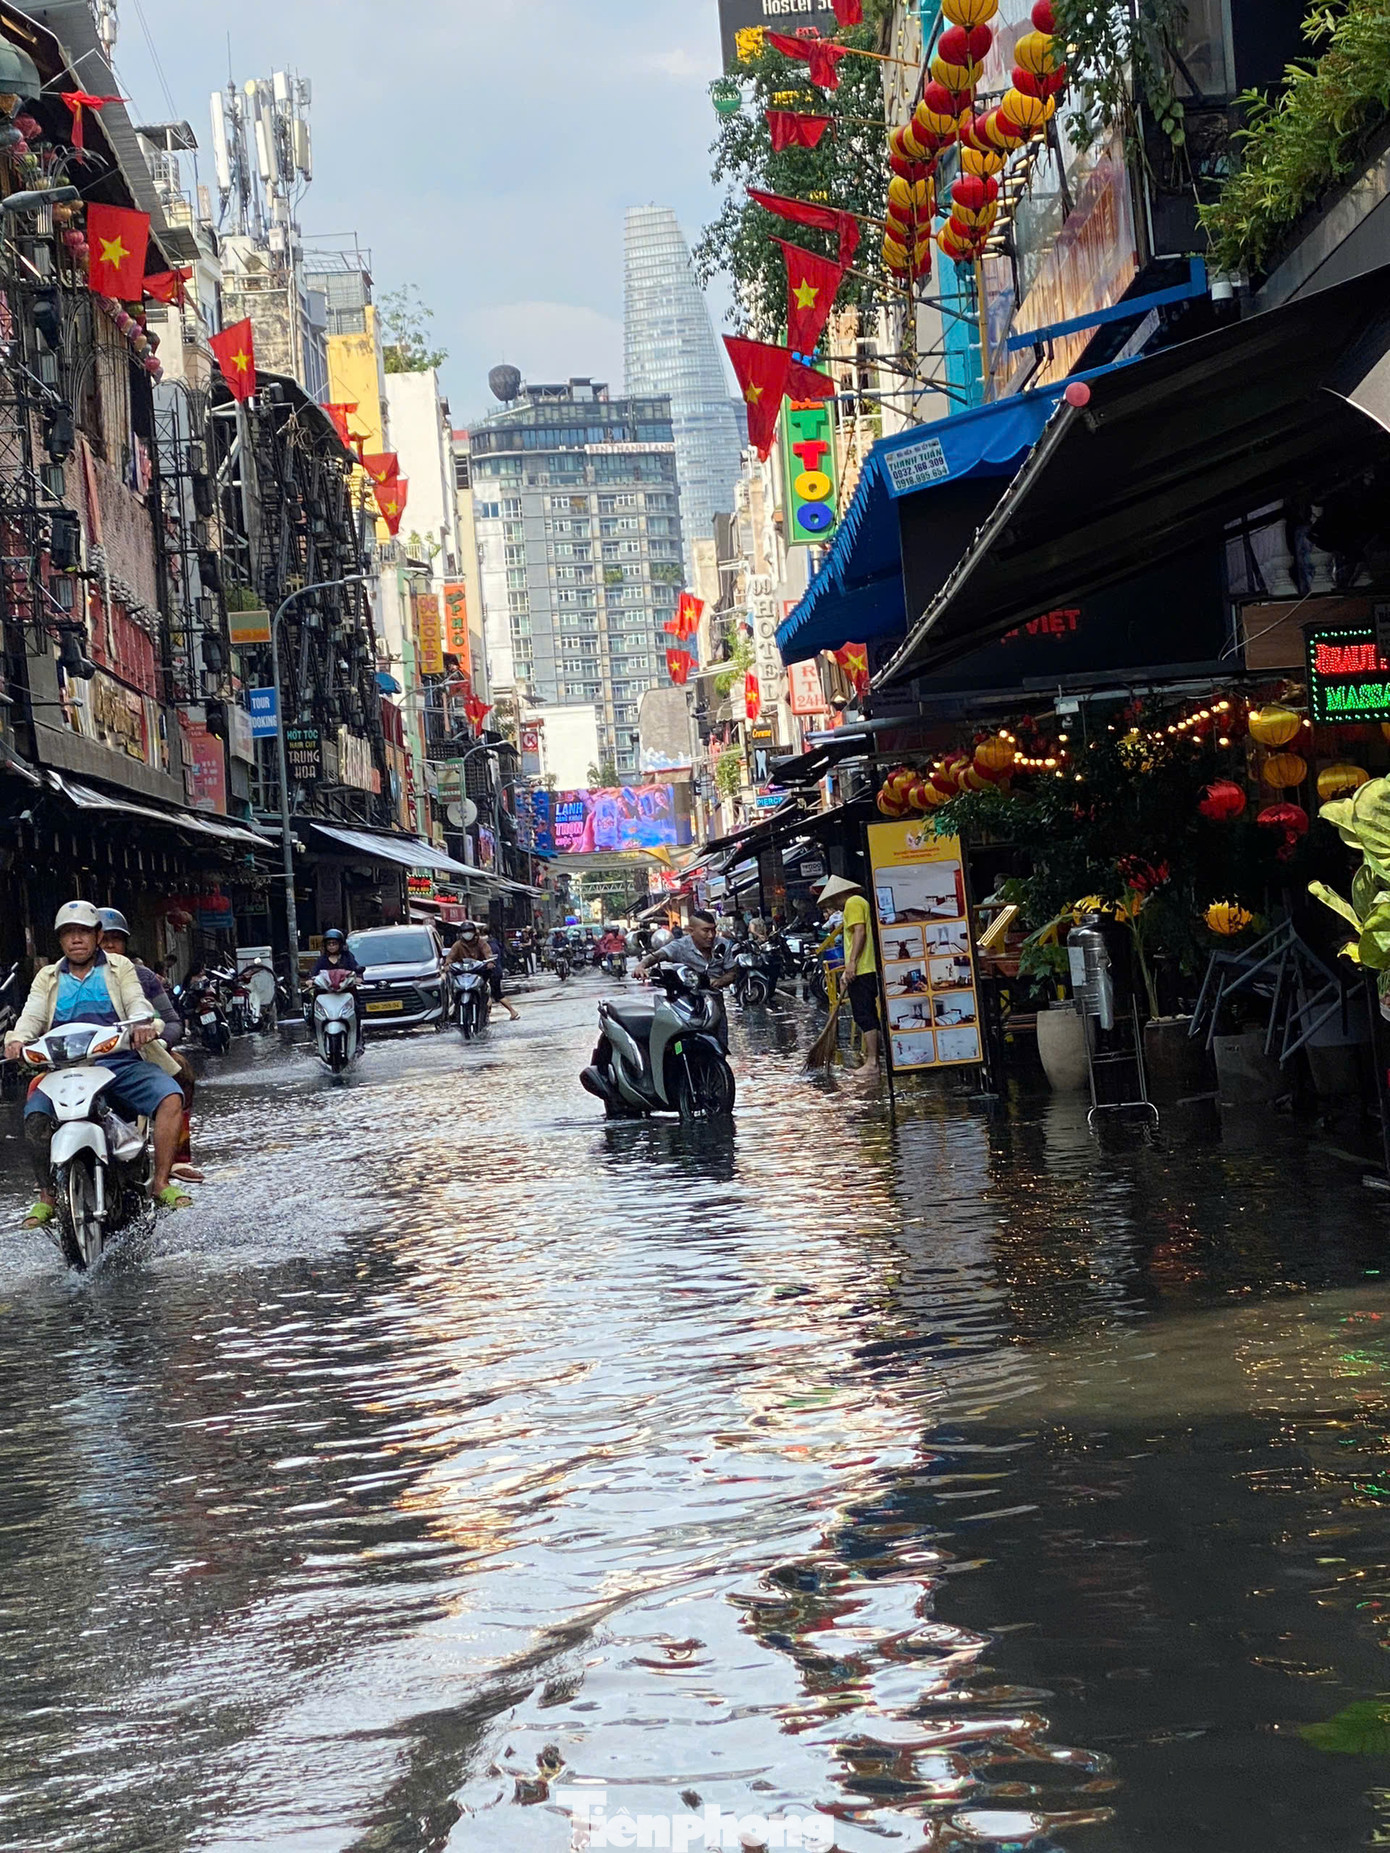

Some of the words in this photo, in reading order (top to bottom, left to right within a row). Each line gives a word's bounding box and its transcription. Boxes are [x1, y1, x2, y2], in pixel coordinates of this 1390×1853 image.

[888, 456, 917, 471] THANH
[753, 579, 771, 596] 99
[421, 615, 440, 671] HOTEL
[755, 600, 779, 701] HOTEL
[251, 696, 271, 709] TOUR
[251, 714, 278, 728] OOKING
[287, 749, 320, 764] TRUNG
